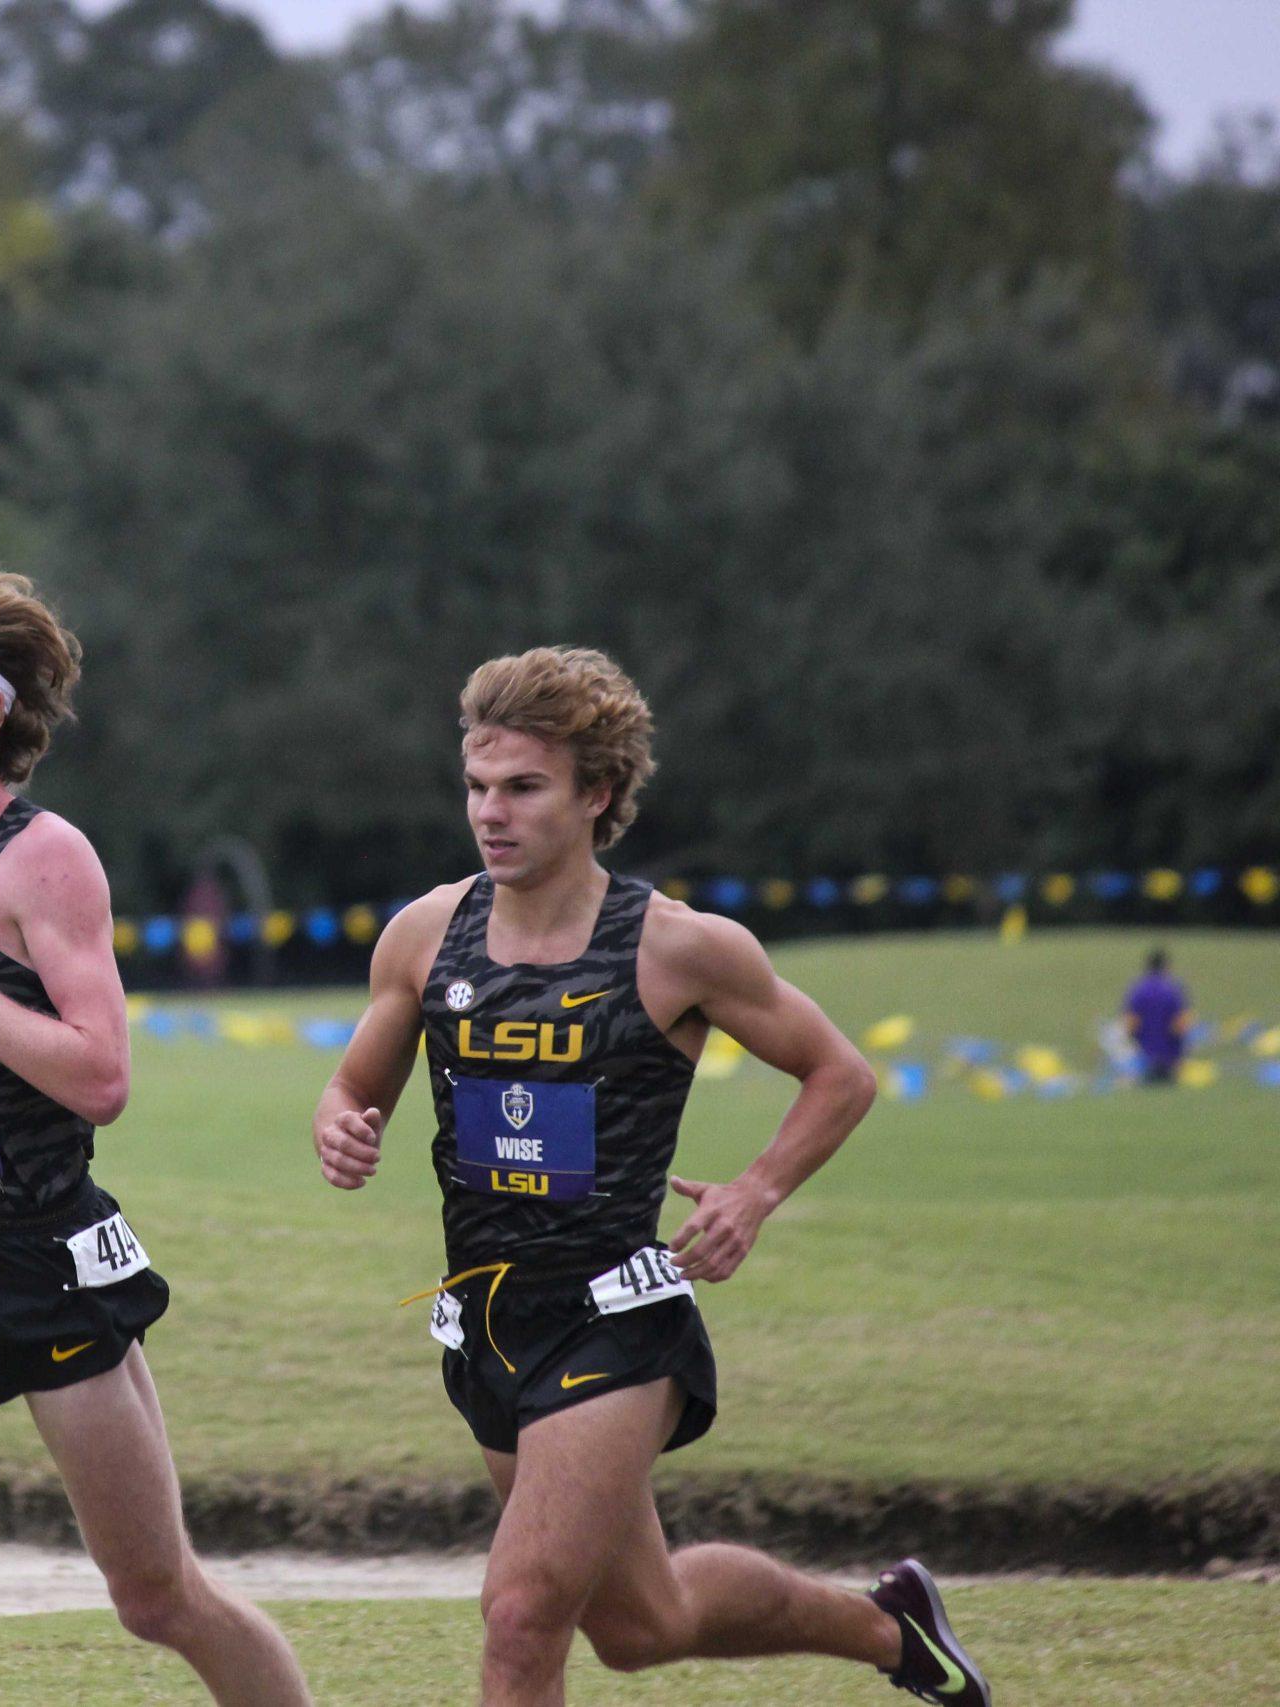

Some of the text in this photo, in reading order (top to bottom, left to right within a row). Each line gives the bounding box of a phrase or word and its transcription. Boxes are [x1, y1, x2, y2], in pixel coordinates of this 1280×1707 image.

[446, 980, 474, 1011] SEC
[458, 1019, 584, 1063] LSU
[495, 1136, 543, 1162] WISE
[491, 1170, 549, 1196] LSU
[97, 1217, 139, 1272] 414
